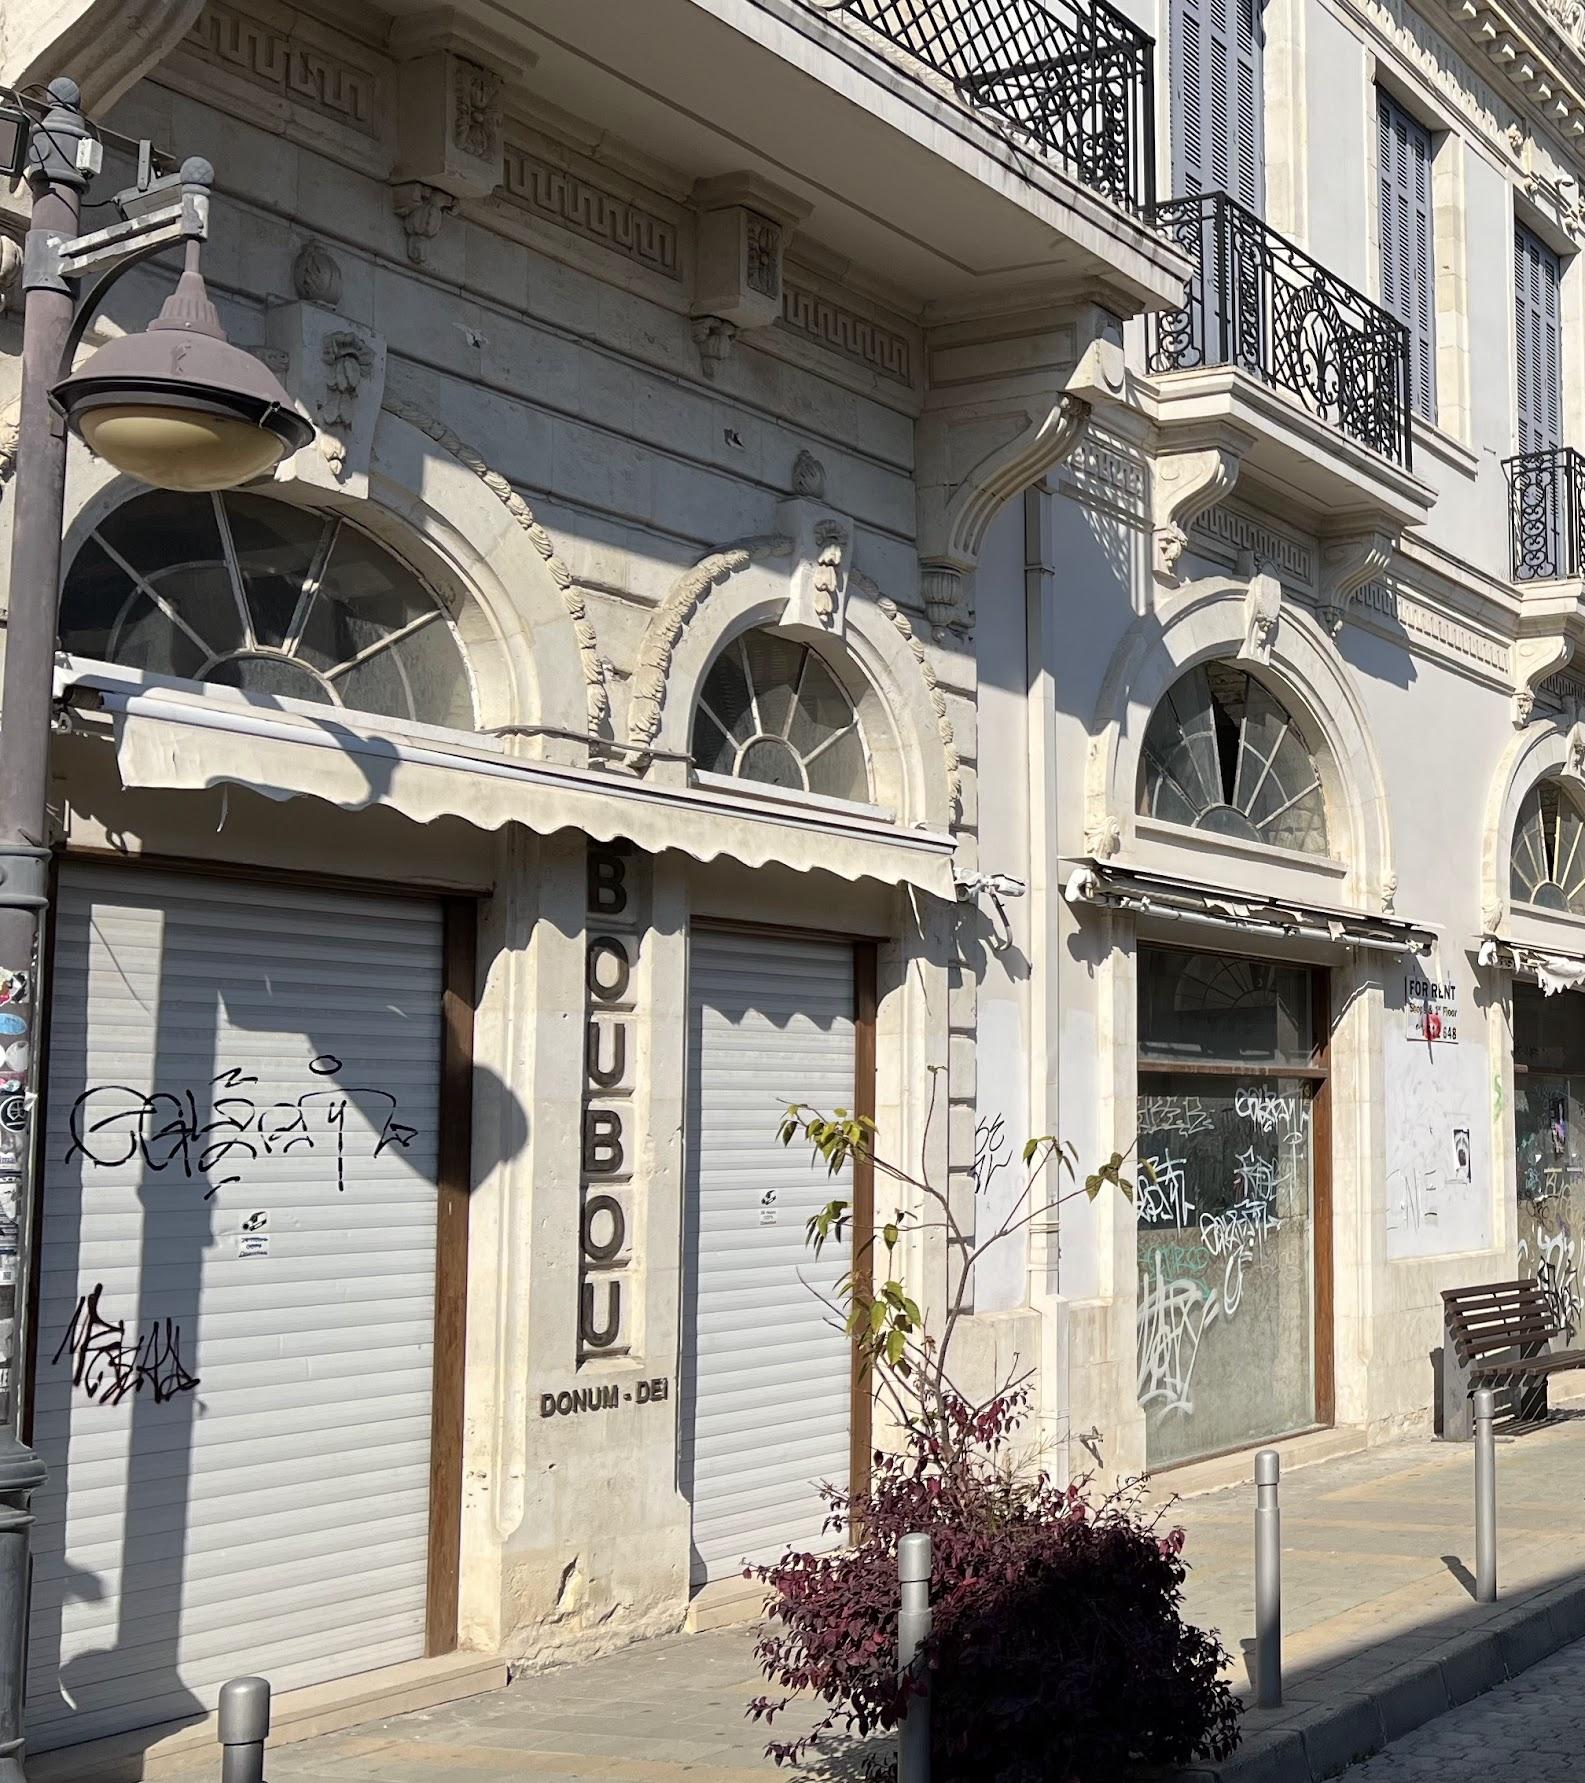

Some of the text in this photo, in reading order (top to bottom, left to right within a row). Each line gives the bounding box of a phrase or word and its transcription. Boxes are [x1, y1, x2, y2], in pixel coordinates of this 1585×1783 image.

[1409, 980, 1456, 1000] FOR RENT
[1442, 1006, 1457, 1017] Floor
[581, 854, 630, 1348] BOUBOU
[540, 1385, 619, 1418] DONUM
[635, 1378, 669, 1405] DEI
